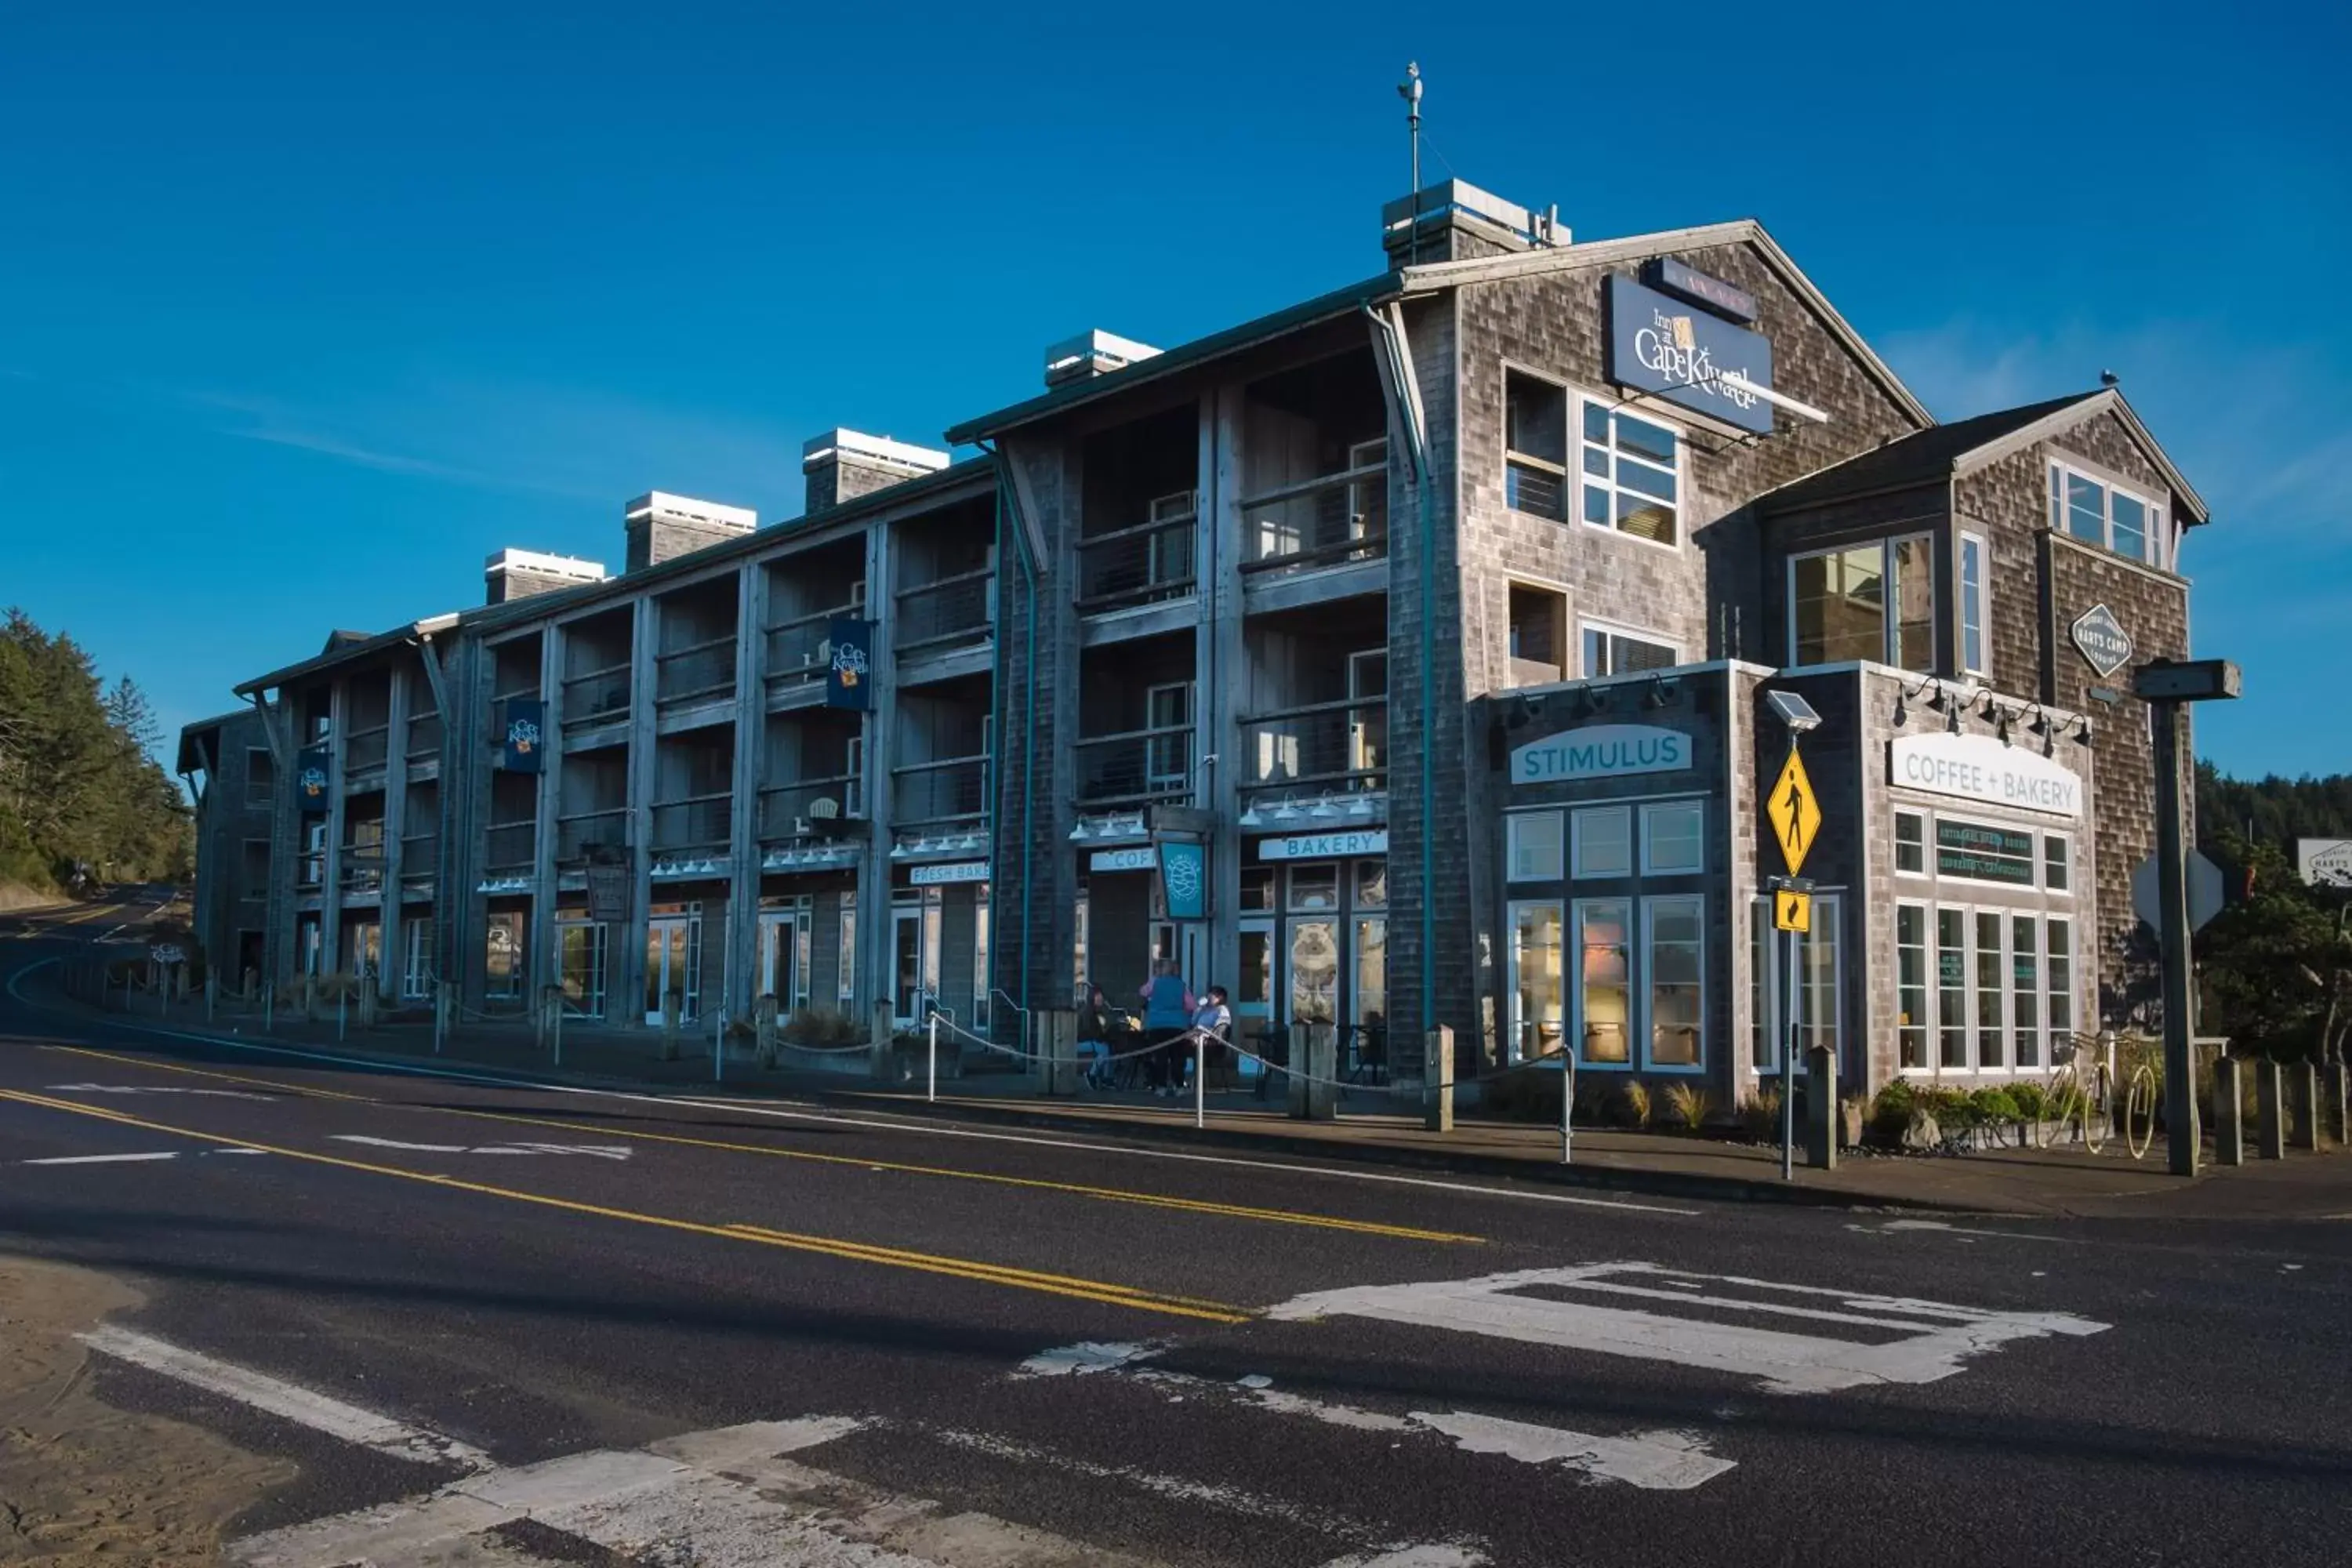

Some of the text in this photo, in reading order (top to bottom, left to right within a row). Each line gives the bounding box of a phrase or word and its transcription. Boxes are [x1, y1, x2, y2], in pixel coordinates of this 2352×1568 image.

[1635, 328, 1686, 382] Cape
[1524, 736, 1679, 776] STIMULUS
[1906, 752, 2074, 808] COFFEE + BAKERY
[1116, 850, 1156, 867] COF
[1287, 834, 1371, 855] BAKERY
[914, 867, 953, 882] FRESH
